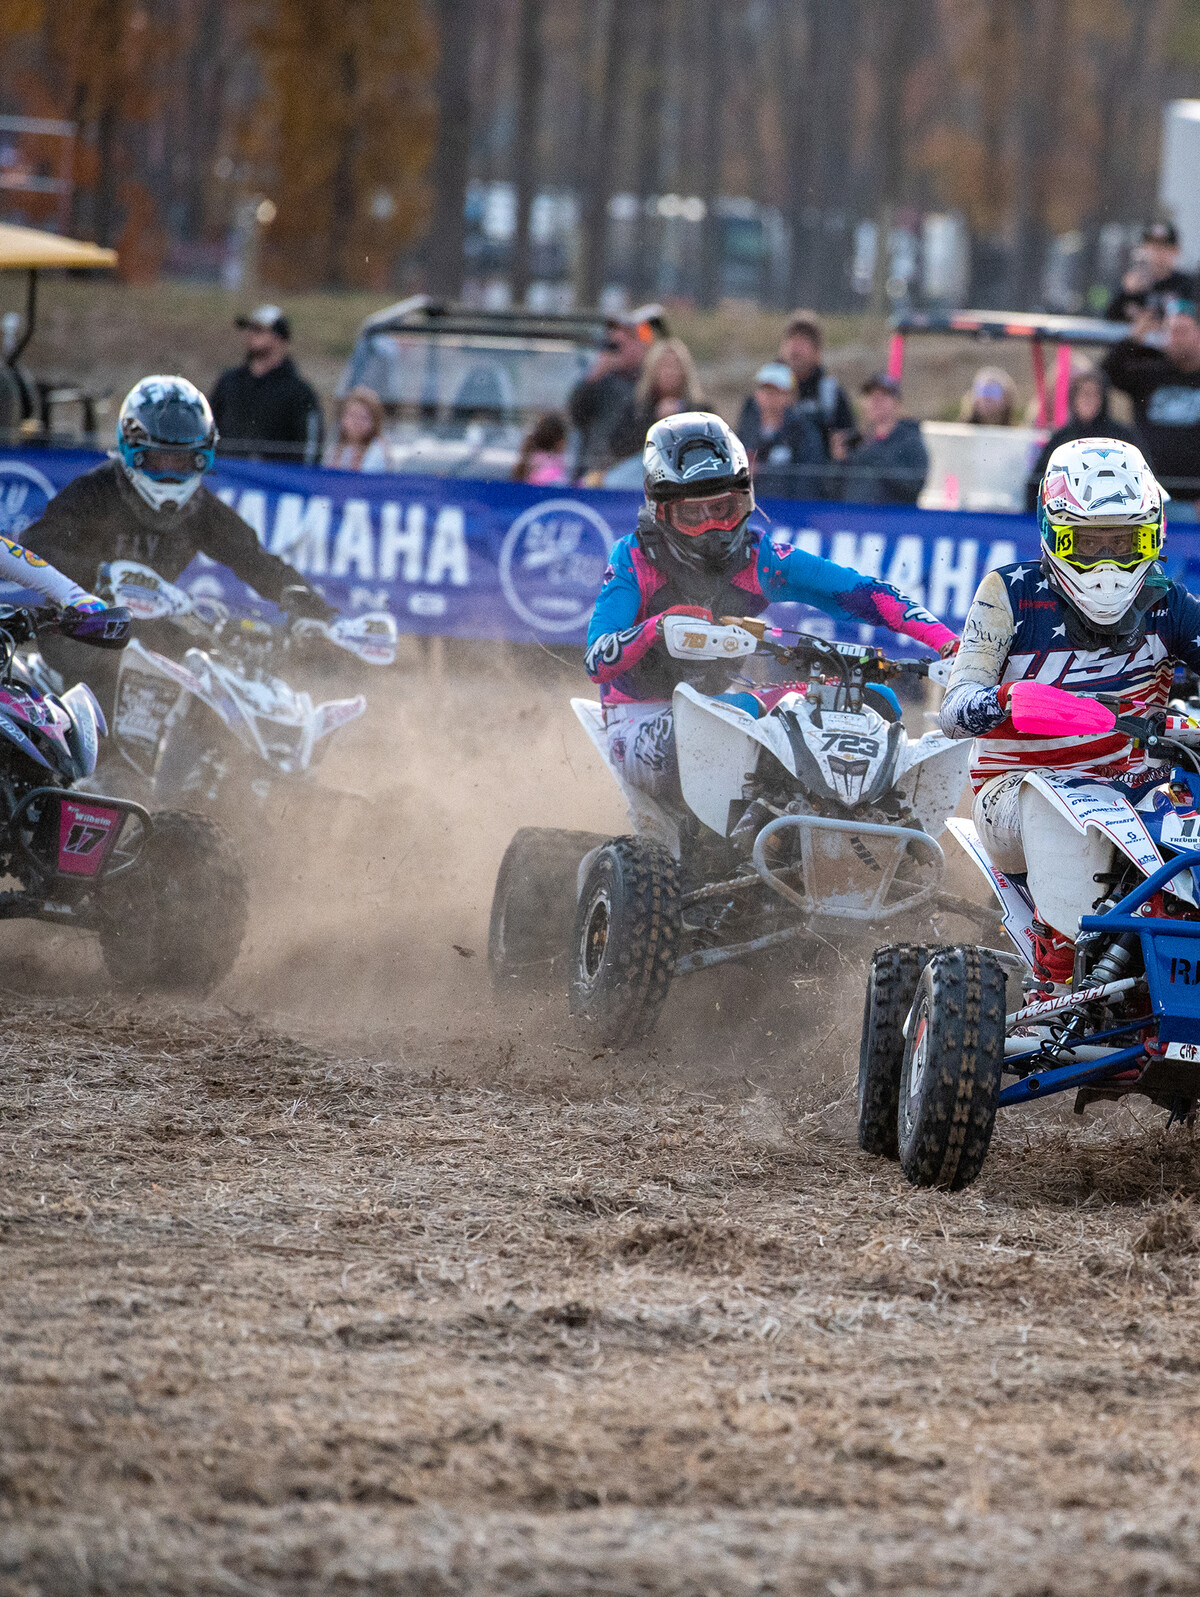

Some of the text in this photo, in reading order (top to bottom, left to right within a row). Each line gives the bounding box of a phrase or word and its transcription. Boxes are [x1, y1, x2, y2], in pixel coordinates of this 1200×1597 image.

[197, 489, 469, 587] AMAHA
[1001, 632, 1169, 685] USA
[820, 733, 880, 759] 723
[63, 822, 110, 856] 17
[1014, 985, 1106, 1022] WALSH
